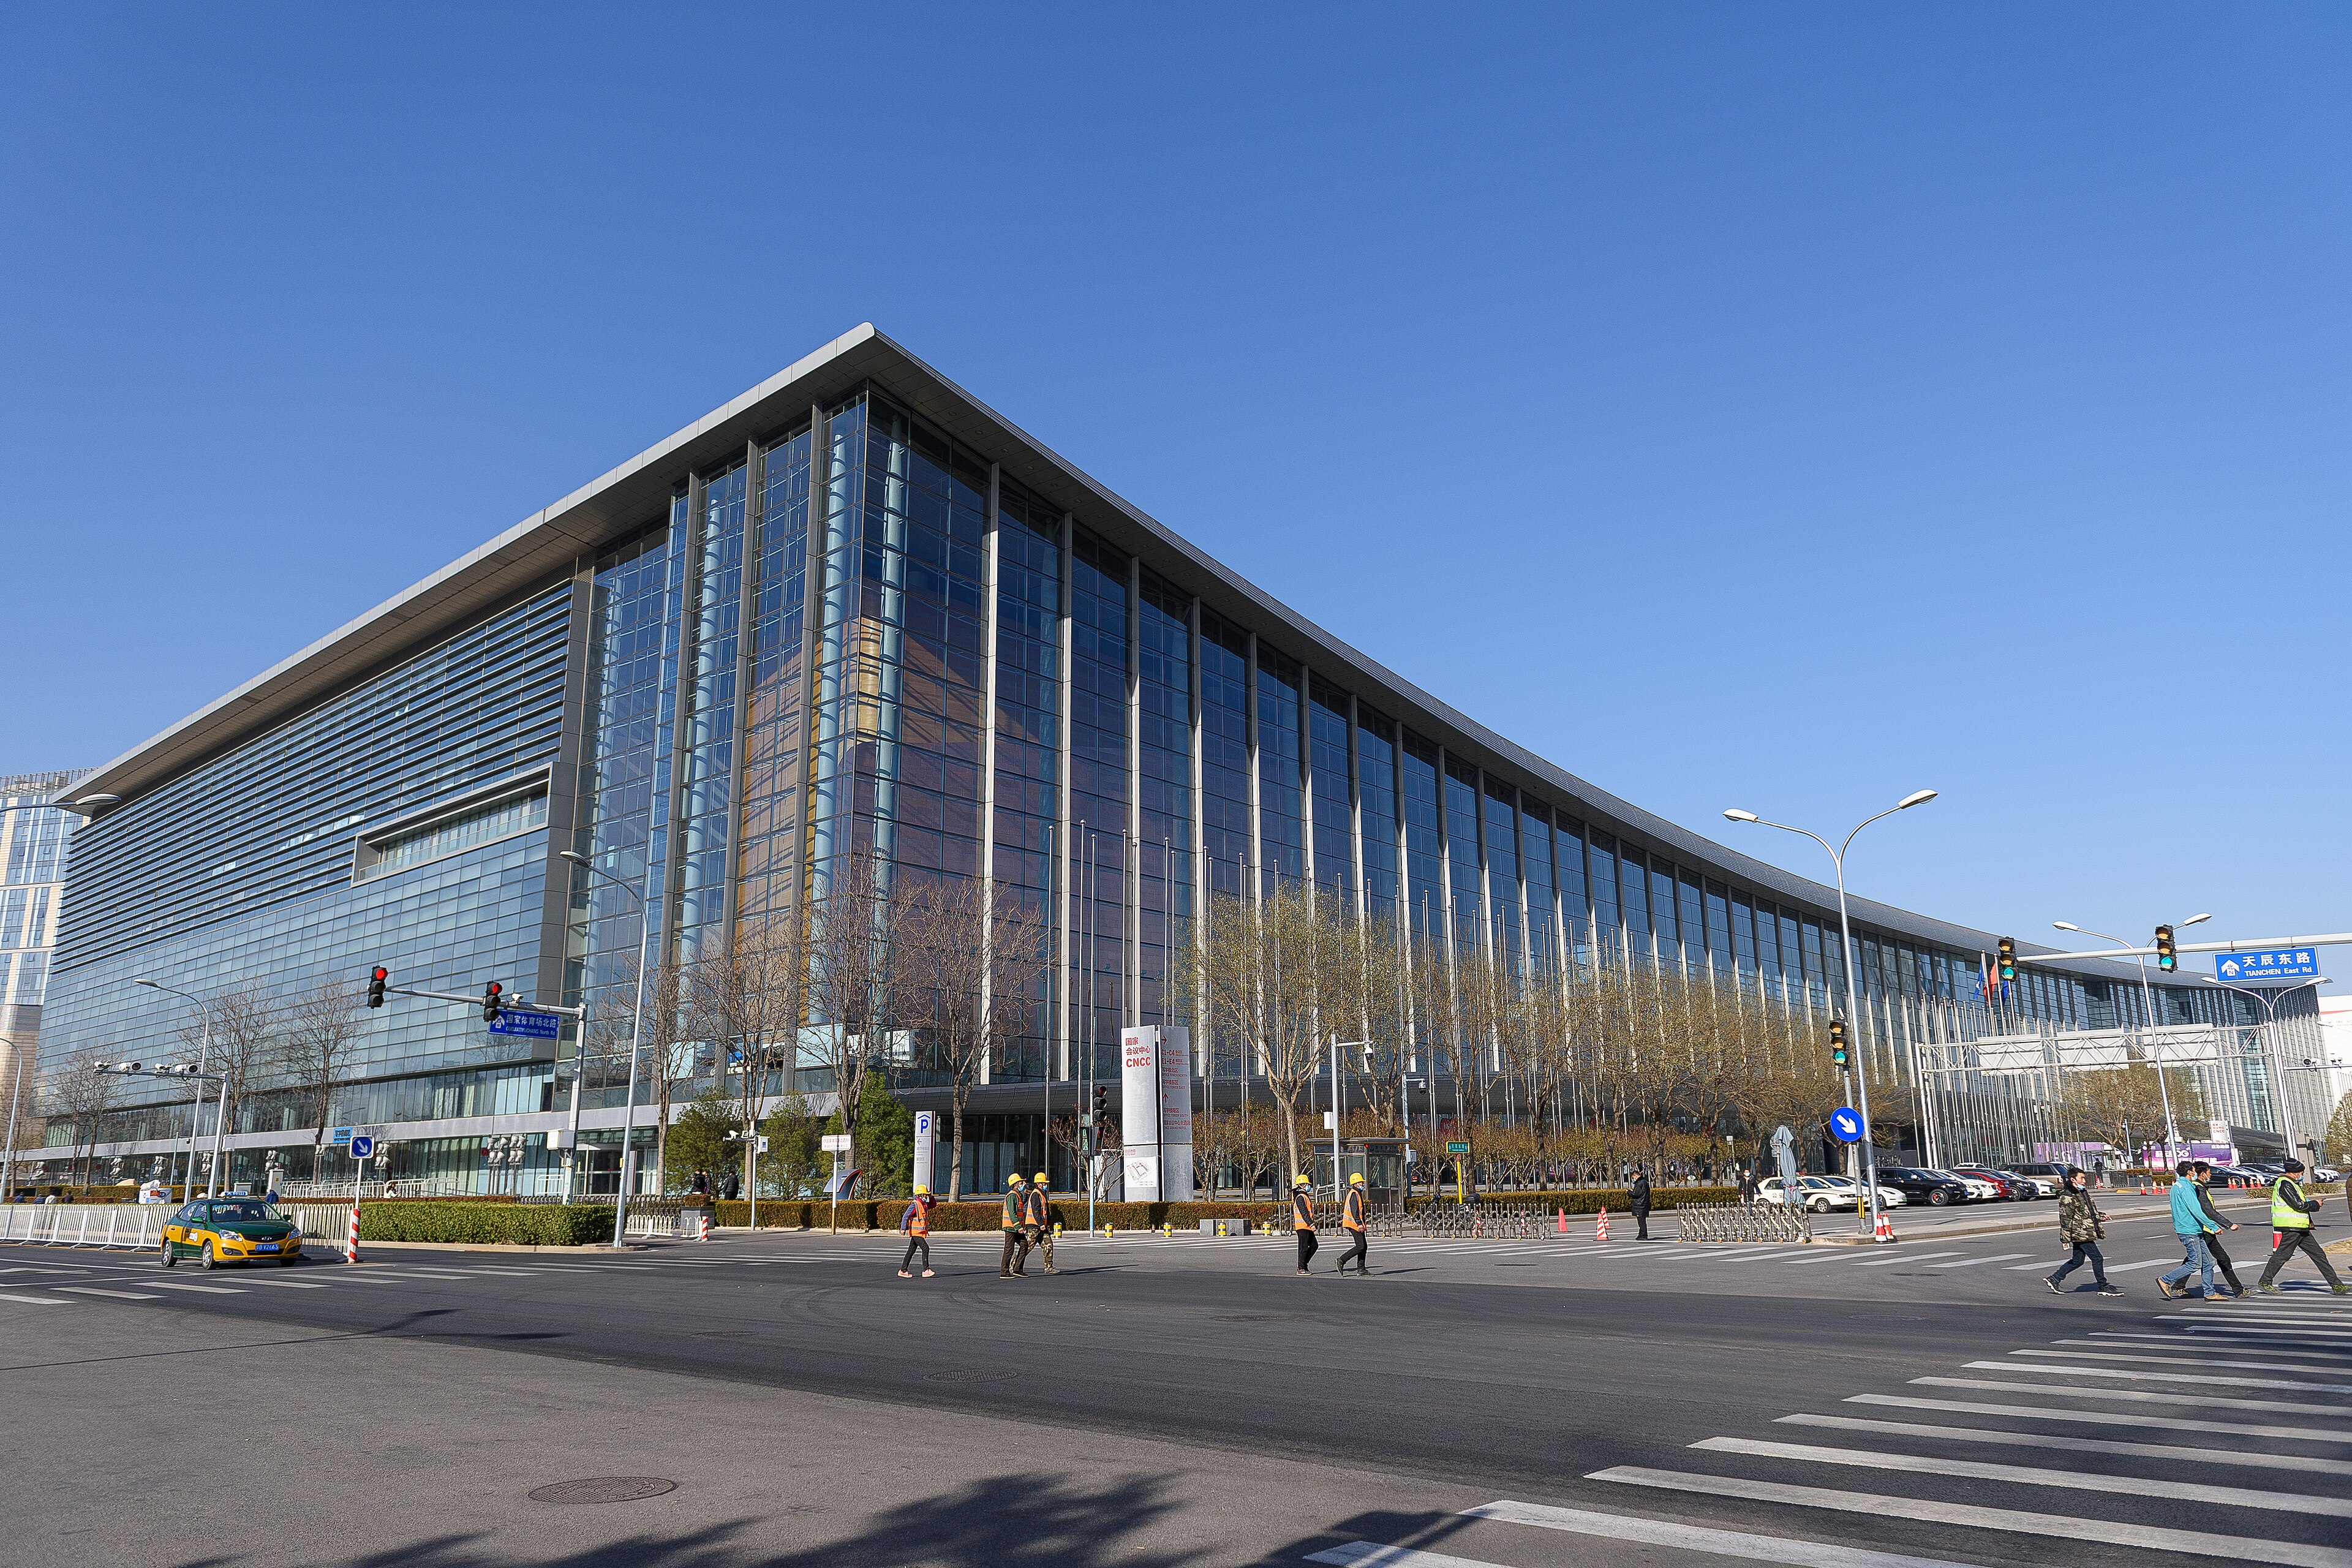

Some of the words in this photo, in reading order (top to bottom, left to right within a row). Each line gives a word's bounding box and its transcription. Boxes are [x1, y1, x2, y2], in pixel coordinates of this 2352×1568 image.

[2242, 952, 2310, 967] 天辰东路
[2244, 968, 2281, 977] TIANCHEN
[506, 1014, 557, 1028] 国家体育场北路
[1126, 1037, 1139, 1046] 国家
[1126, 1046, 1151, 1055] 会议中心
[1126, 1057, 1151, 1068] CNCC
[921, 1119, 929, 1133] P
